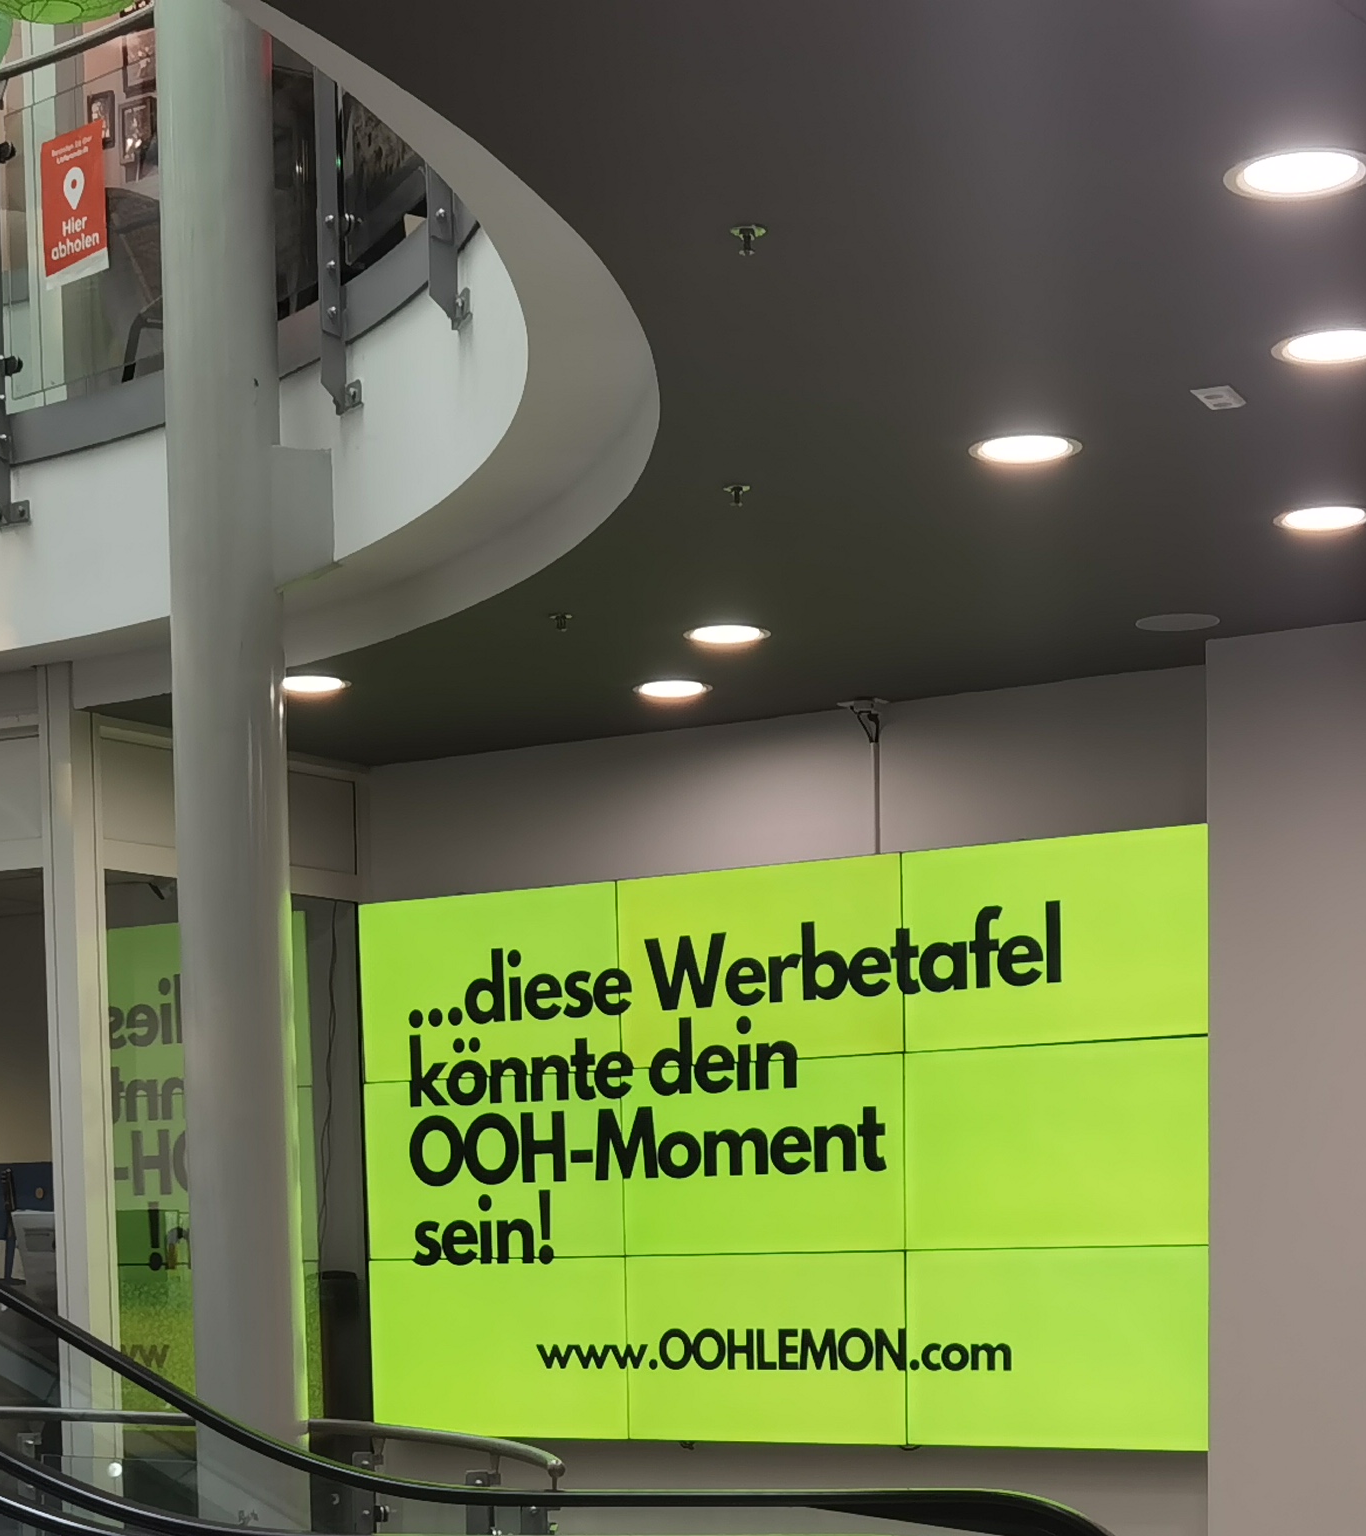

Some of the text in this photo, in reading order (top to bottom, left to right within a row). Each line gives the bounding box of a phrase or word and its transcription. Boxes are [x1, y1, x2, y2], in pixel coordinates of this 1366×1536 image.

[51, 232, 100, 261] abholen
[62, 216, 87, 237] Hier
[408, 900, 1062, 1029] ...diese Werbetafel
[408, 1015, 798, 1107] könnte dein
[408, 1105, 887, 1187] OOH-Moment
[413, 1189, 555, 1267] sein!
[536, 1327, 1013, 1372] www.OOHLEMON.com
